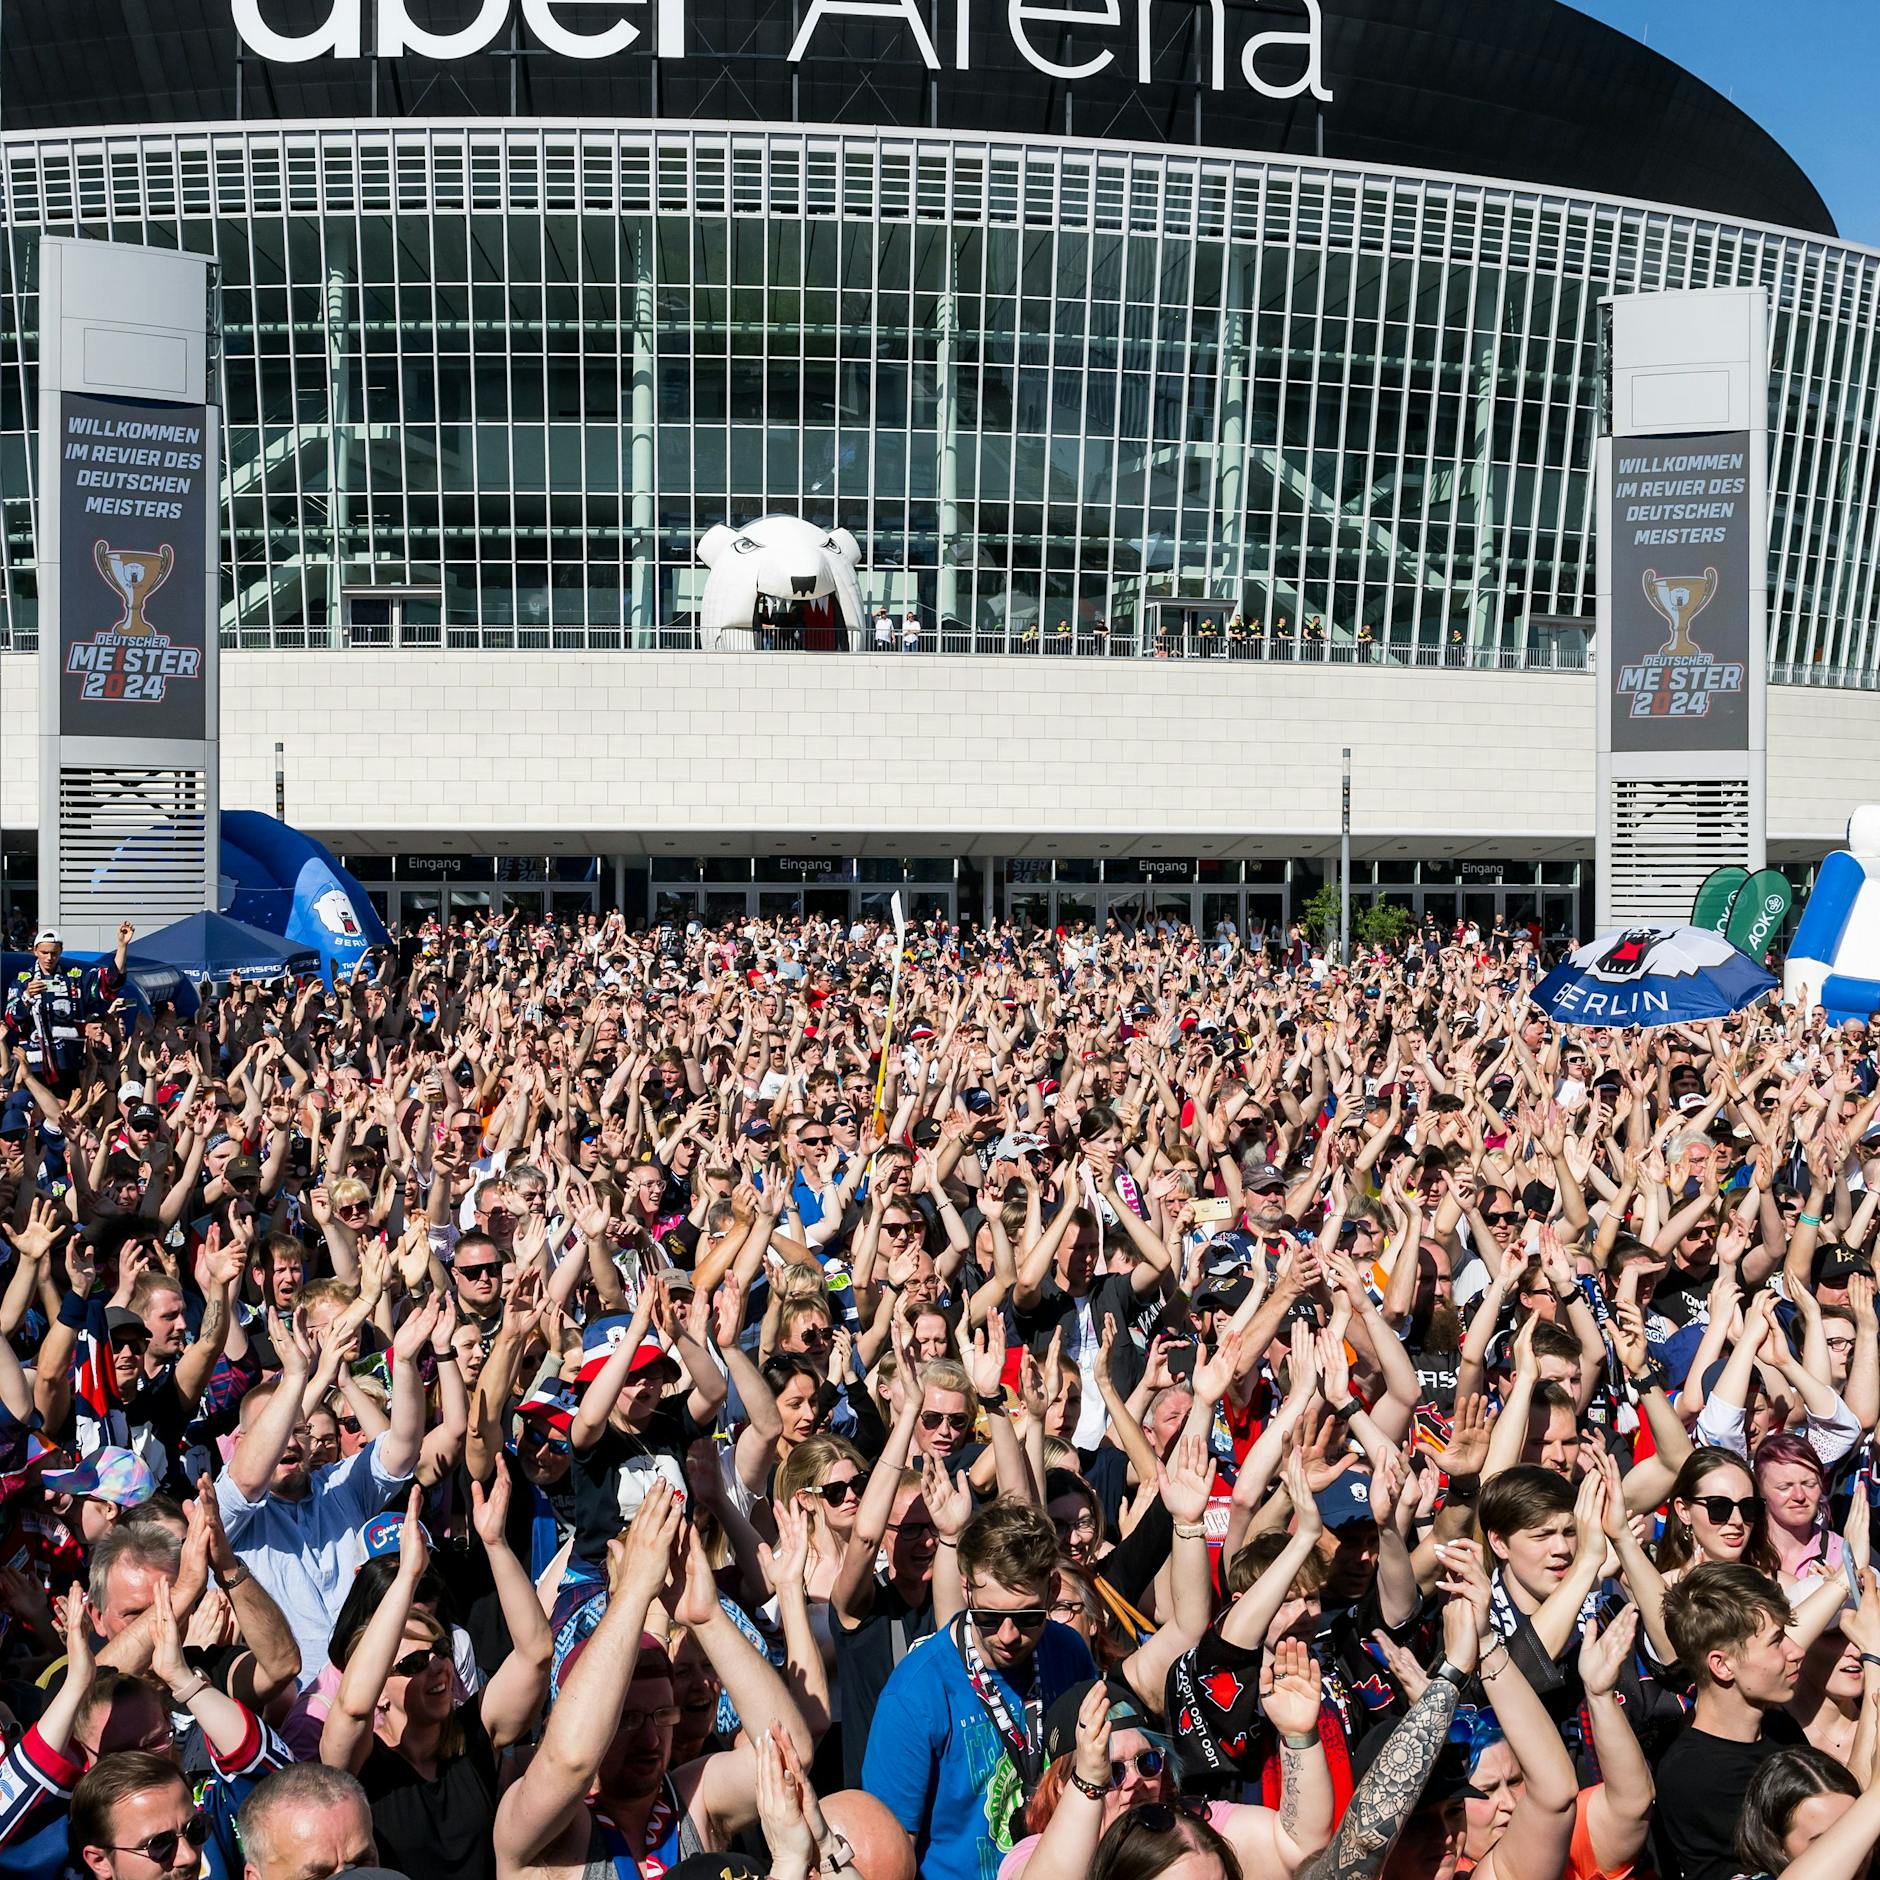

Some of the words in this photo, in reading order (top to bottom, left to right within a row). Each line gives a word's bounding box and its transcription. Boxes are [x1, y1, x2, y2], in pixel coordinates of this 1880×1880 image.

[68, 417, 200, 443] WILLKOMMEN
[65, 444, 87, 461] IM
[91, 446, 162, 467] REVIER
[164, 452, 202, 470] DES
[1618, 454, 1743, 474] WILLKOMMEN
[77, 470, 191, 494] DEUTSCHEN
[1616, 482, 1637, 498] IM
[1640, 479, 1705, 497] REVIER
[1709, 477, 1745, 495] DES
[85, 496, 183, 520] MEISTERS
[1626, 502, 1734, 522] DEUTSCHEN
[1634, 527, 1726, 546] MEISTERS
[97, 634, 168, 649] DEUTSCHER
[70, 645, 198, 675] MEISTER
[1644, 655, 1712, 667] DEUTSCHER
[85, 673, 164, 700] 2024
[1620, 665, 1741, 691] MEISTER
[1633, 691, 1709, 716] 2024
[408, 856, 461, 871] Eingang
[779, 858, 832, 873] Eingang
[1138, 859, 1188, 873] Eingang
[1461, 862, 1504, 876] Eingang
[1748, 913, 1775, 951] AOK
[237, 964, 282, 975] GASAG
[1552, 982, 1669, 1016] BERLIN
[1181, 1675, 1196, 1705] LIGO
[1190, 1707, 1207, 1737] LIGO
[1202, 1738, 1220, 1768] LIGO
